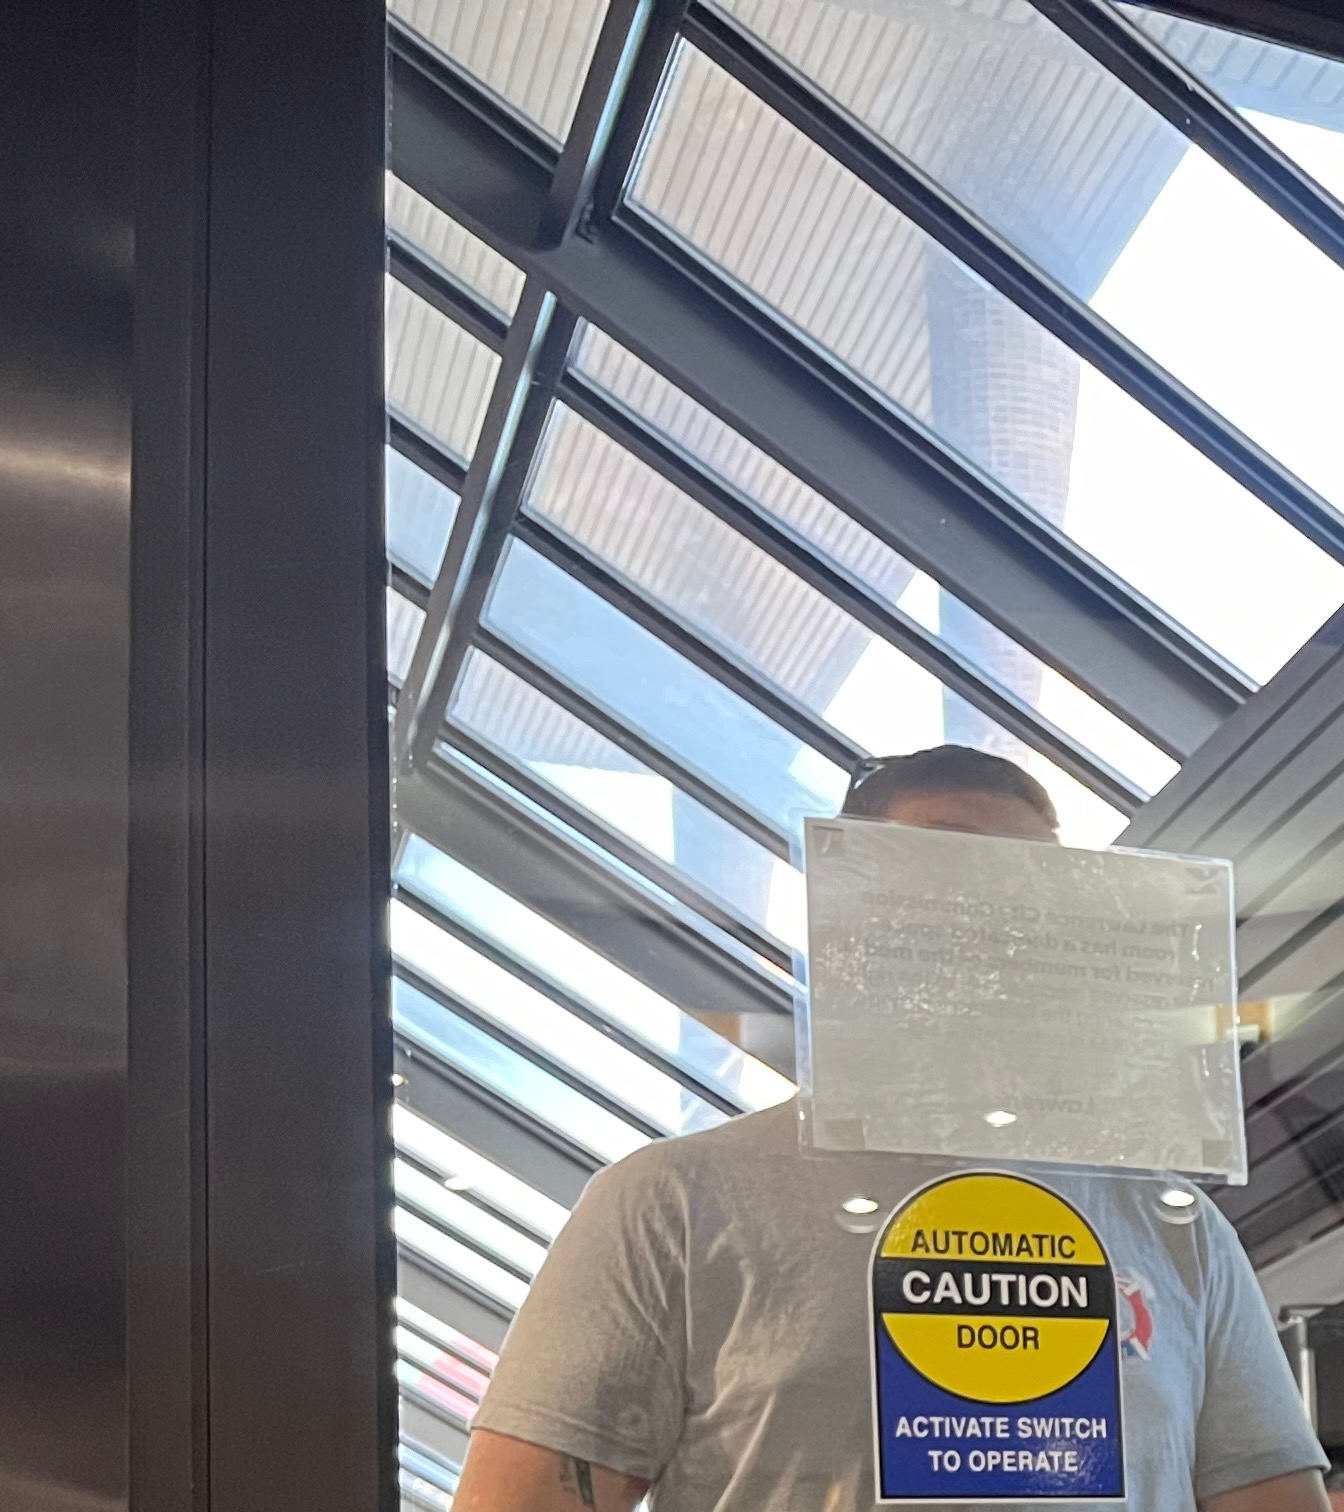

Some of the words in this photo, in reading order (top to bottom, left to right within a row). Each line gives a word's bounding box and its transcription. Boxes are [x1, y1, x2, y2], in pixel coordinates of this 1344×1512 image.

[911, 1229, 1076, 1259] AUTOMATIC
[902, 1270, 1088, 1308] CAUTION
[957, 1324, 1040, 1350] DOOR
[896, 1416, 1010, 1438] ACTIVATE
[1017, 1417, 1107, 1439] SWITCH
[928, 1450, 961, 1472] TO
[968, 1450, 1078, 1472] OPERATE
